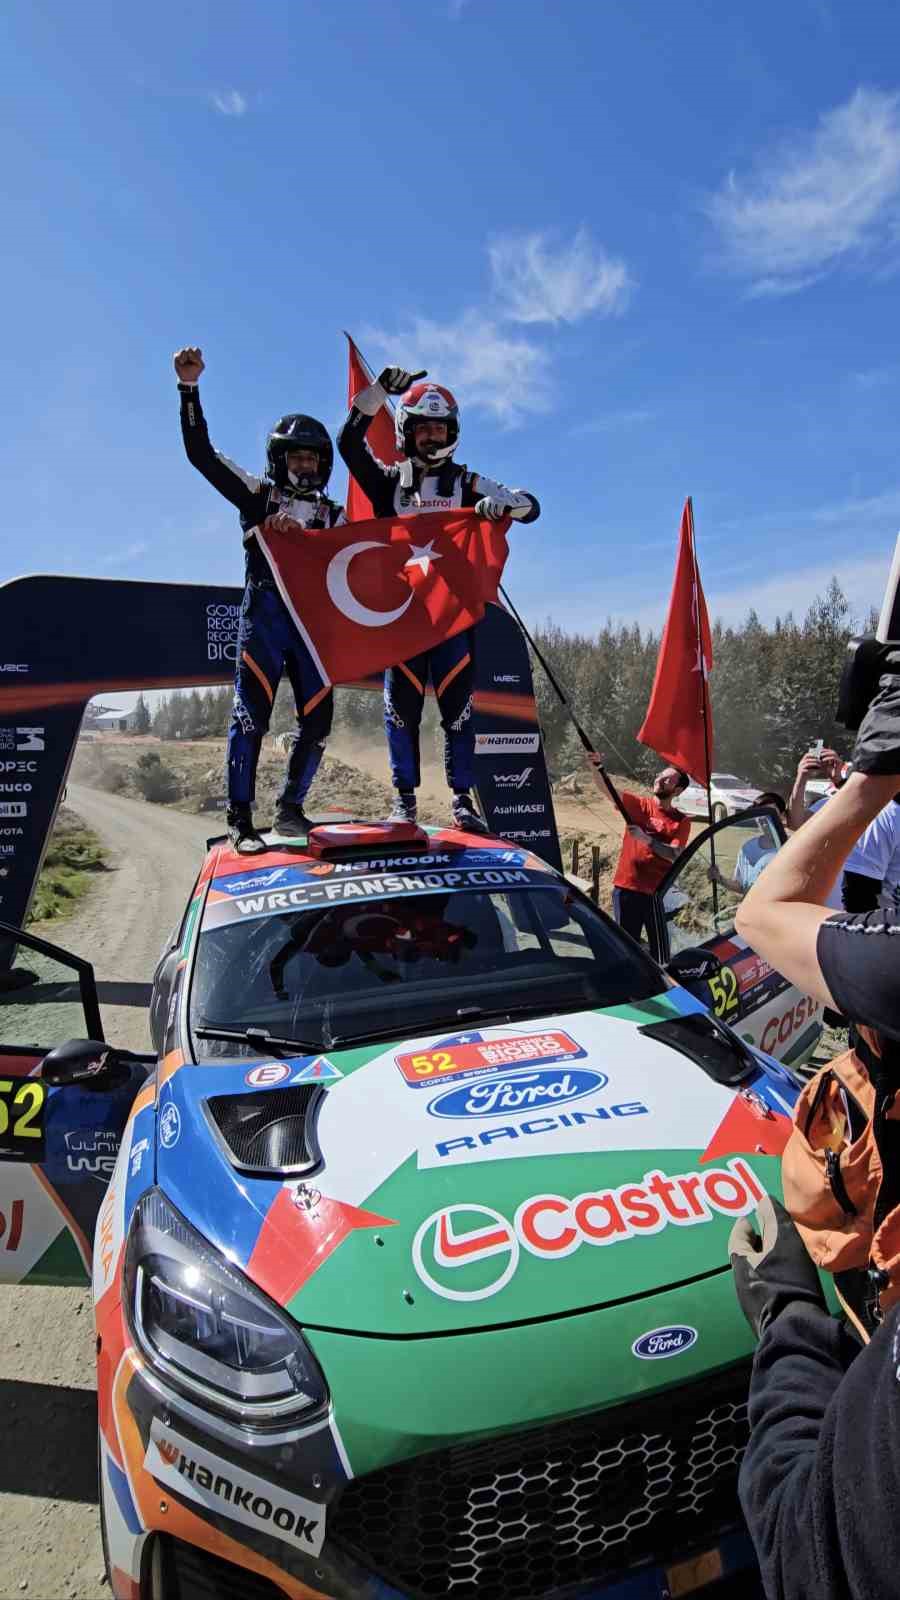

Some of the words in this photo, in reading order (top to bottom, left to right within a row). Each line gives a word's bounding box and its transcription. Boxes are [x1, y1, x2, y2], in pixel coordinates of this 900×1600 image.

[207, 604, 240, 617] GOBI
[493, 672, 520, 682] WRC
[235, 870, 531, 915] WRC-FANSHOP.COM
[709, 966, 738, 1017] 52
[411, 1052, 457, 1075] 52
[464, 1074, 578, 1114] Ford
[435, 1102, 648, 1157] RACING
[520, 1161, 764, 1252] Castrol
